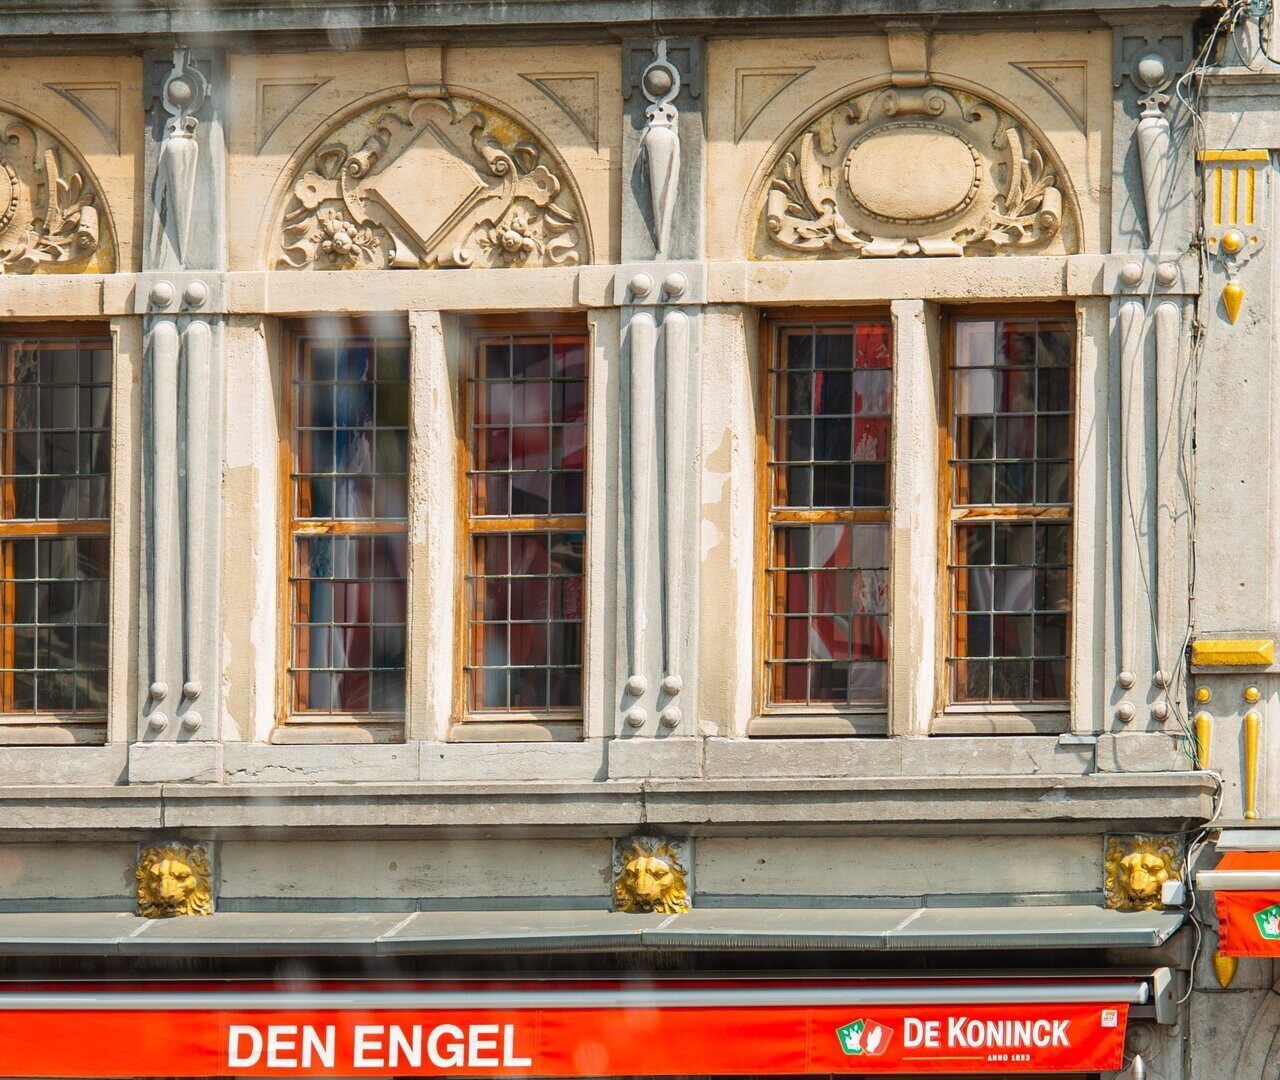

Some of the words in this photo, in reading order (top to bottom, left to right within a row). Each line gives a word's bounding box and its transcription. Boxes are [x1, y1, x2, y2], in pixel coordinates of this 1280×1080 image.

[227, 1024, 336, 1068] DEN
[352, 1023, 532, 1068] ENGEL
[903, 1017, 941, 1048] DE
[947, 1016, 1070, 1048] KONINCK
[987, 1054, 1008, 1062] ANNO
